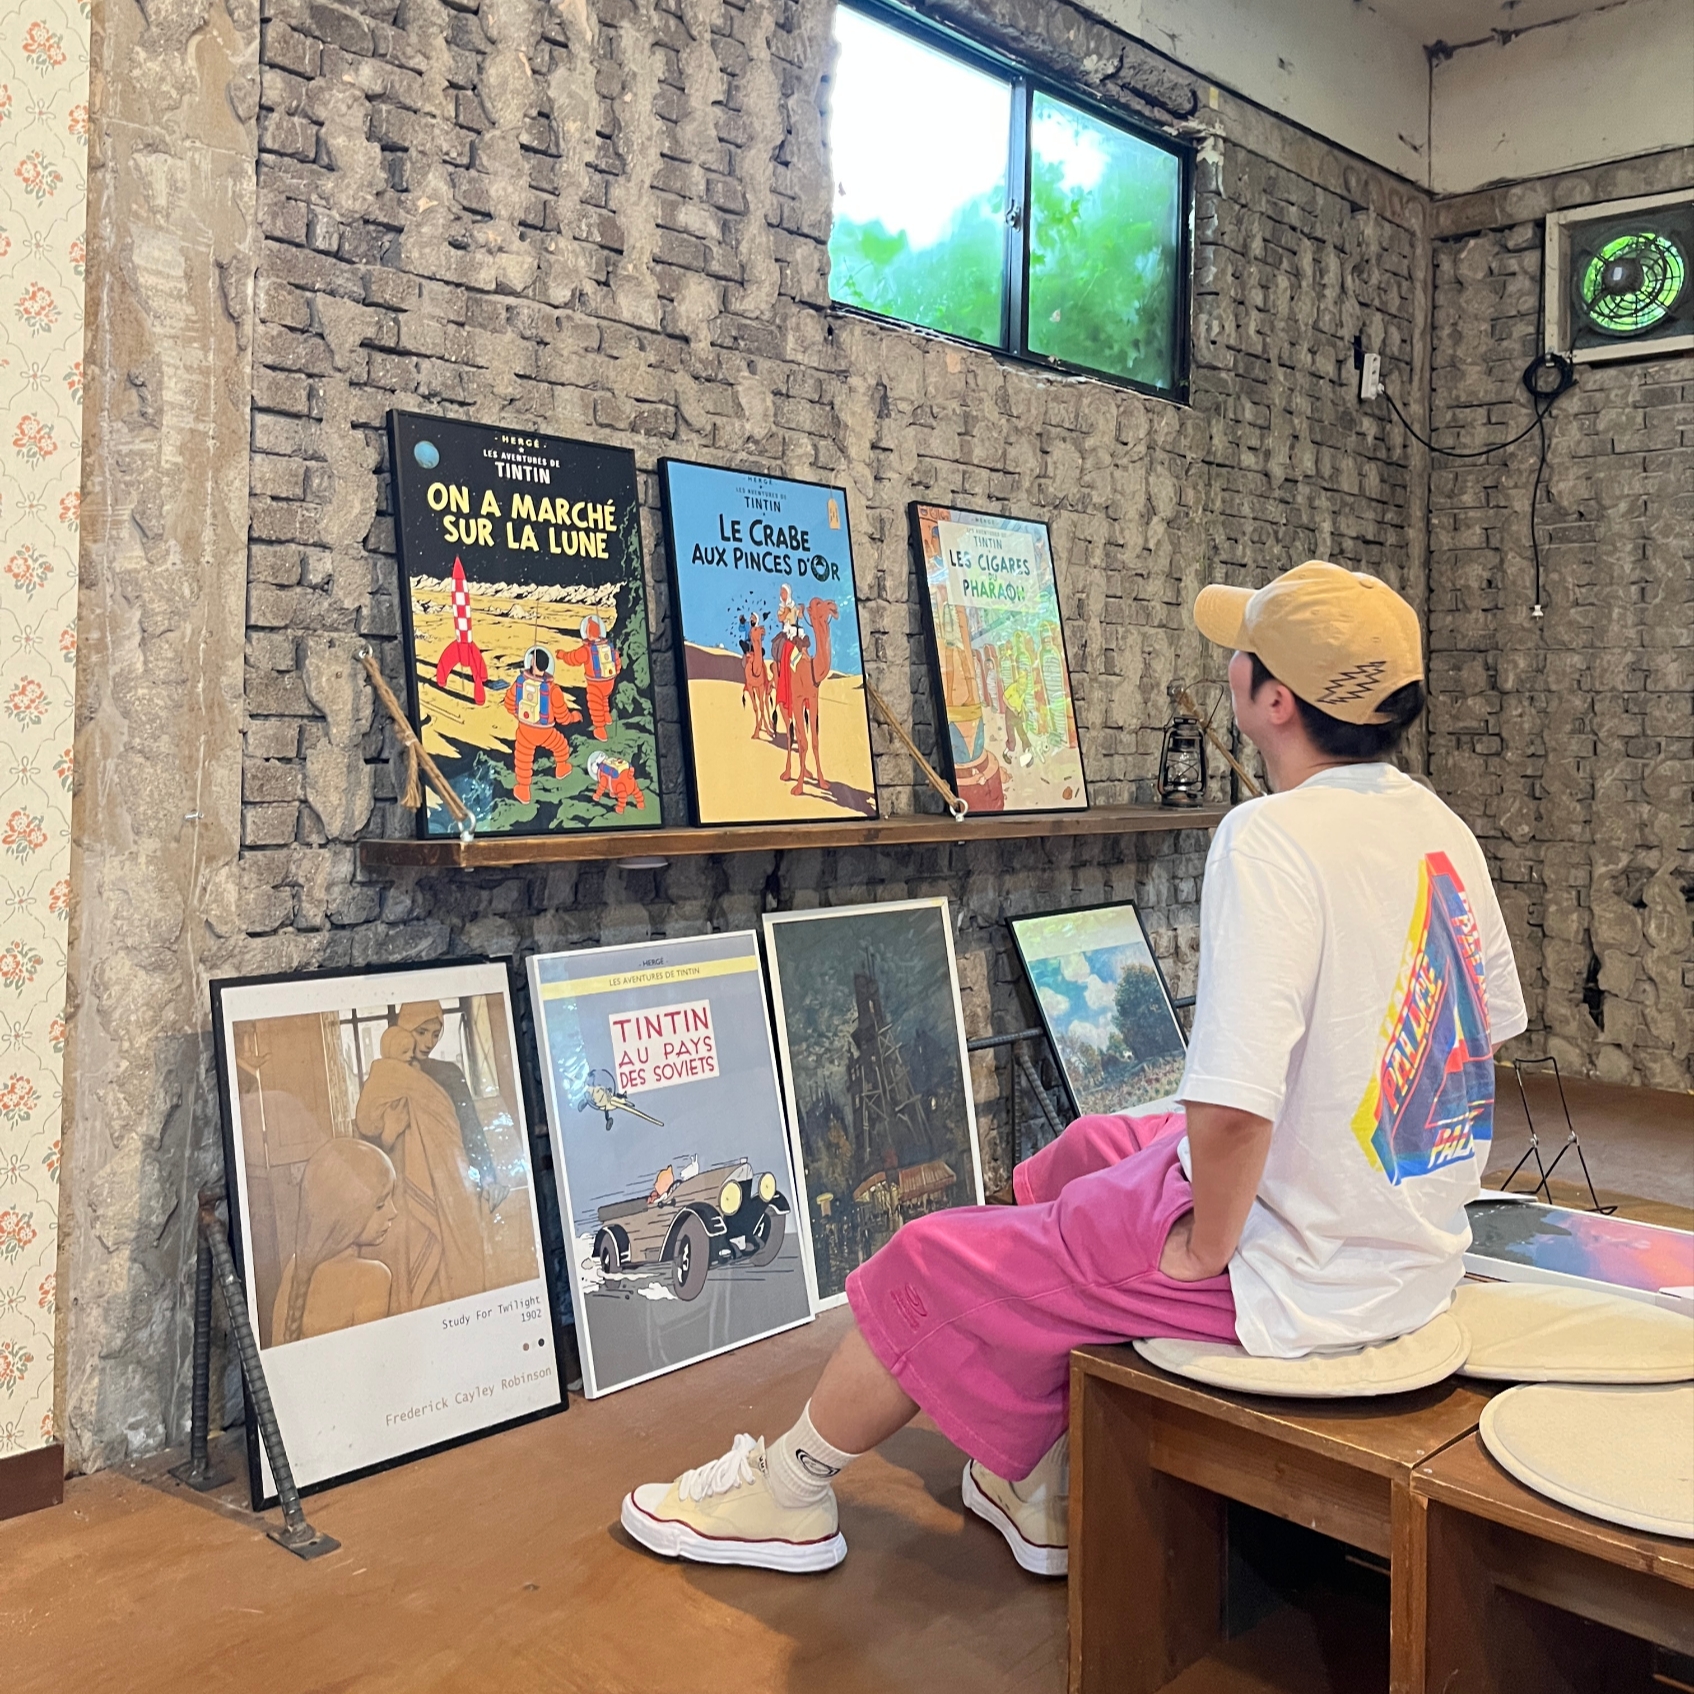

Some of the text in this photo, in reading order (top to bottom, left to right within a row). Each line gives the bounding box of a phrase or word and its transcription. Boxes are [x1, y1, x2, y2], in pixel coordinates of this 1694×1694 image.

[502, 434, 539, 448] HERGÉ
[483, 449, 560, 468] LES AVENTURES DE
[494, 462, 550, 484] TINTIN
[427, 482, 618, 532] ON A MARCHÉ
[744, 496, 781, 513] TINTIN
[443, 515, 609, 560] SUR LA LUNE
[720, 514, 811, 552] LE CRABE
[974, 536, 1002, 550] TINTIN
[692, 543, 840, 582] AUX PINCES D'OR
[950, 549, 1030, 576] LES CIGARES
[988, 572, 998, 582] DU
[963, 578, 1026, 603] PHARAON
[642, 957, 664, 967] HERGÉ
[610, 967, 700, 986] LES AVENTURES DE TINTIN
[613, 1006, 710, 1043] TINTIN
[618, 1036, 712, 1068] AU PAYS
[620, 1056, 715, 1090] DES SOVIETS
[442, 1295, 542, 1330] Study For Twilight
[521, 1309, 542, 1323] 1902
[386, 1366, 552, 1426] Frederick Cayley Robinson
